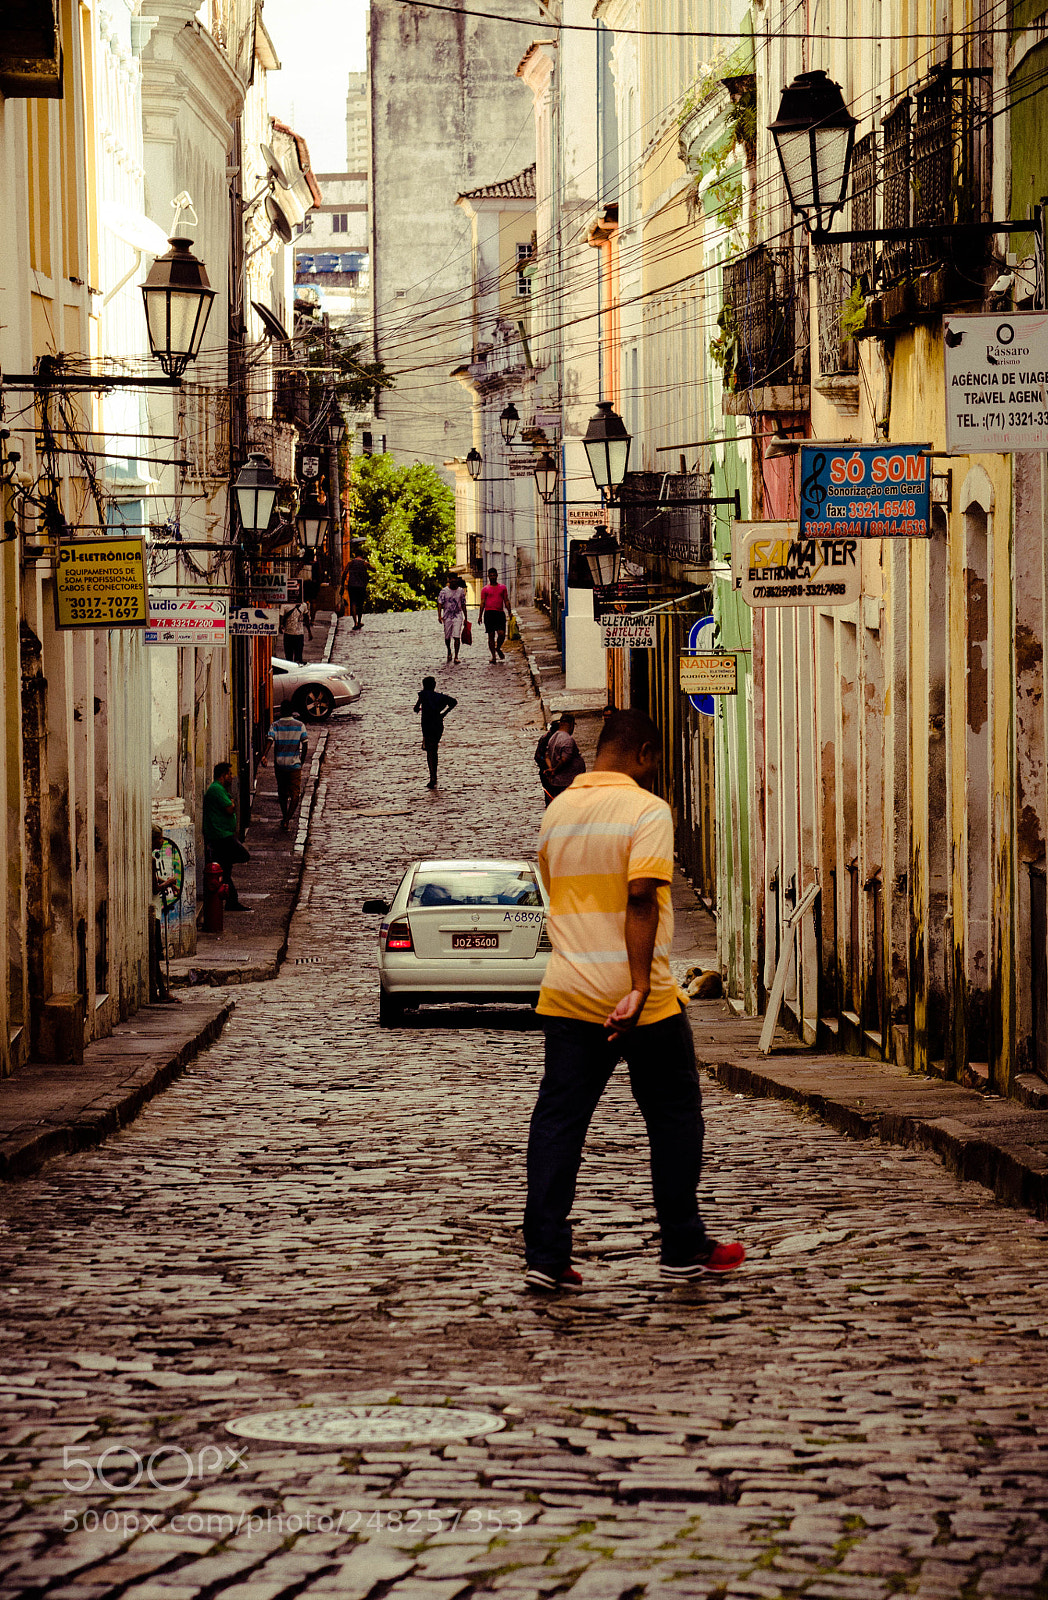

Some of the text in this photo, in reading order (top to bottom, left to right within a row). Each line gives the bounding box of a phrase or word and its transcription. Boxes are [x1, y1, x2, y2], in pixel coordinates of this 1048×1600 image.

[986, 345, 1029, 357] Pássaro
[951, 371, 999, 387] AGÊNCIA
[1002, 372, 1016, 385] DE
[964, 391, 1006, 405] TRAVEL
[957, 413, 979, 428] TEL.
[829, 451, 927, 484] SÓ SOM
[827, 482, 925, 498] Sonorização em Geral
[826, 500, 916, 519] fax: 3321-6548
[804, 520, 861, 538] 3322-6344
[870, 518, 927, 536] 8814-4533
[65, 567, 135, 576] EQUIPAMENTOS DE
[59, 584, 85, 592] CABOS
[93, 583, 143, 591] CONECTORES
[70, 596, 139, 608] 3017-7072
[70, 607, 139, 619] 3322-1697
[171, 619, 214, 628] 3321-7200
[679, 658, 735, 670] NANDO
